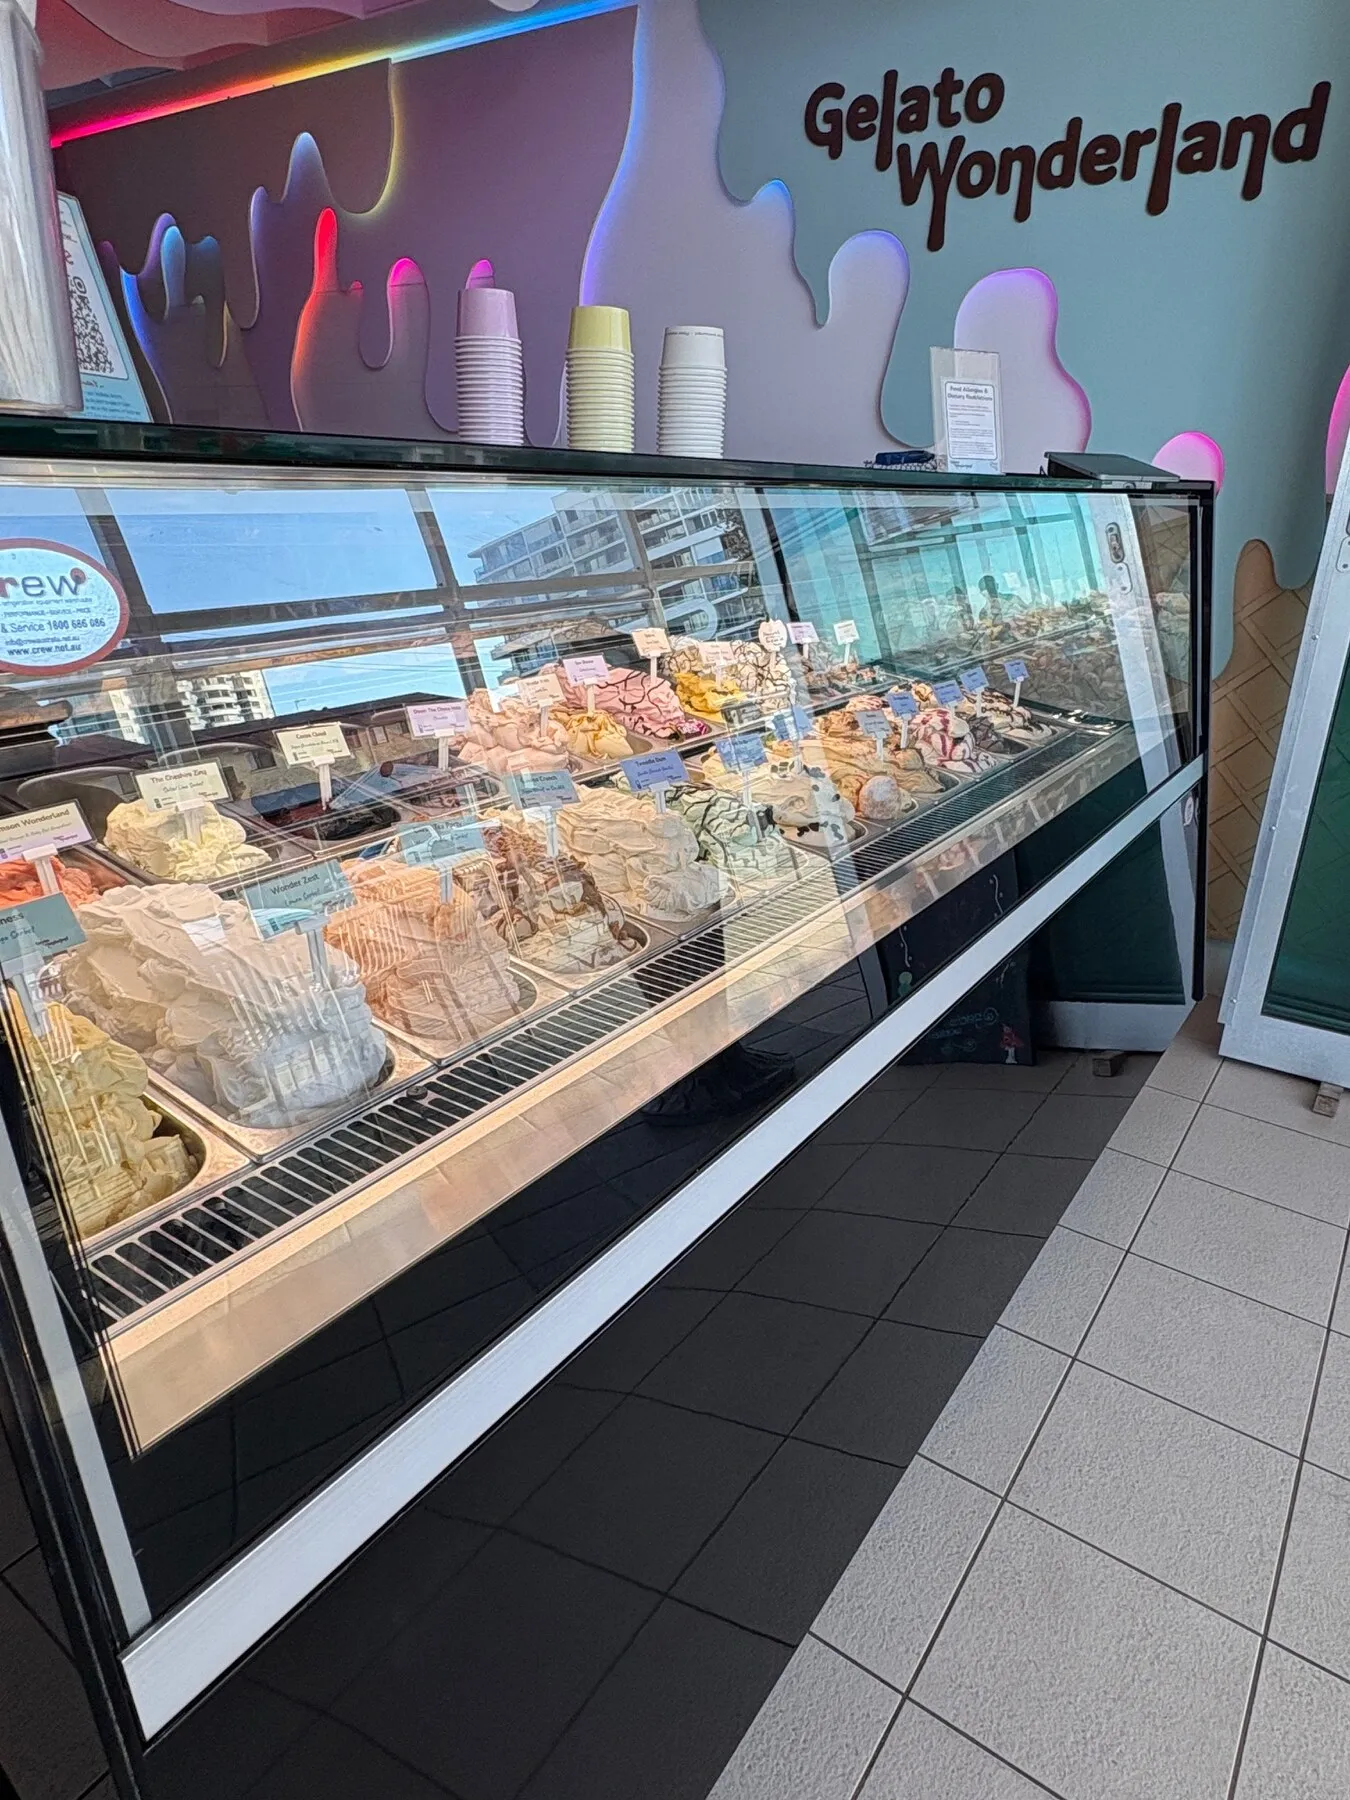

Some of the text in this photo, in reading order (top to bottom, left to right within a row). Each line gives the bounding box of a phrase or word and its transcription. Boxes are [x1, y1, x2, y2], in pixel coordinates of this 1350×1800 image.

[804, 67, 1005, 172] Gelato
[896, 81, 1332, 252] Wonderland
[10, 622, 46, 634] Service
[21, 808, 70, 827] Wonderland
[270, 873, 320, 895] Wonder Zest
